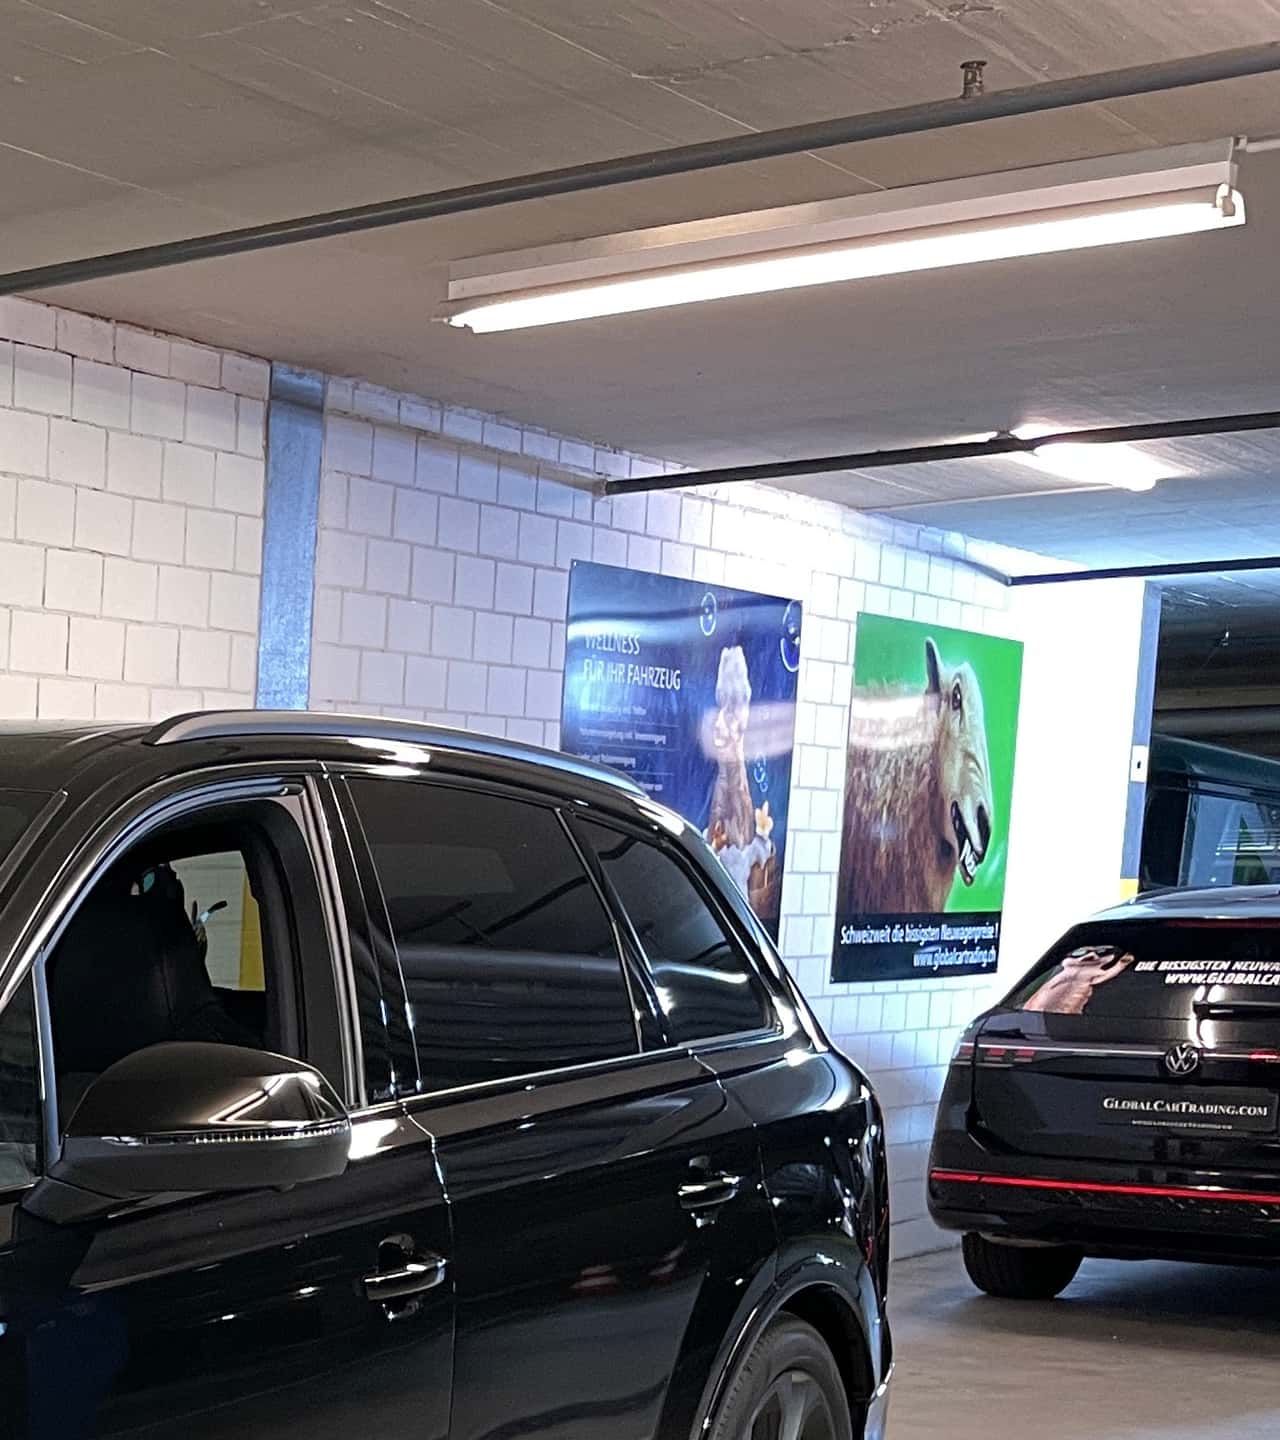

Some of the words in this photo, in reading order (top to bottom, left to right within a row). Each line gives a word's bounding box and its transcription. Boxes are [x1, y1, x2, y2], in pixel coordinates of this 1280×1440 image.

[627, 663, 681, 690] FAHRZEUG
[840, 924, 891, 945] Schweizweit
[892, 923, 905, 944] die
[905, 923, 940, 946] bissigsten
[1134, 960, 1159, 972] DIE
[1157, 960, 1232, 972] BISSIGSTEN
